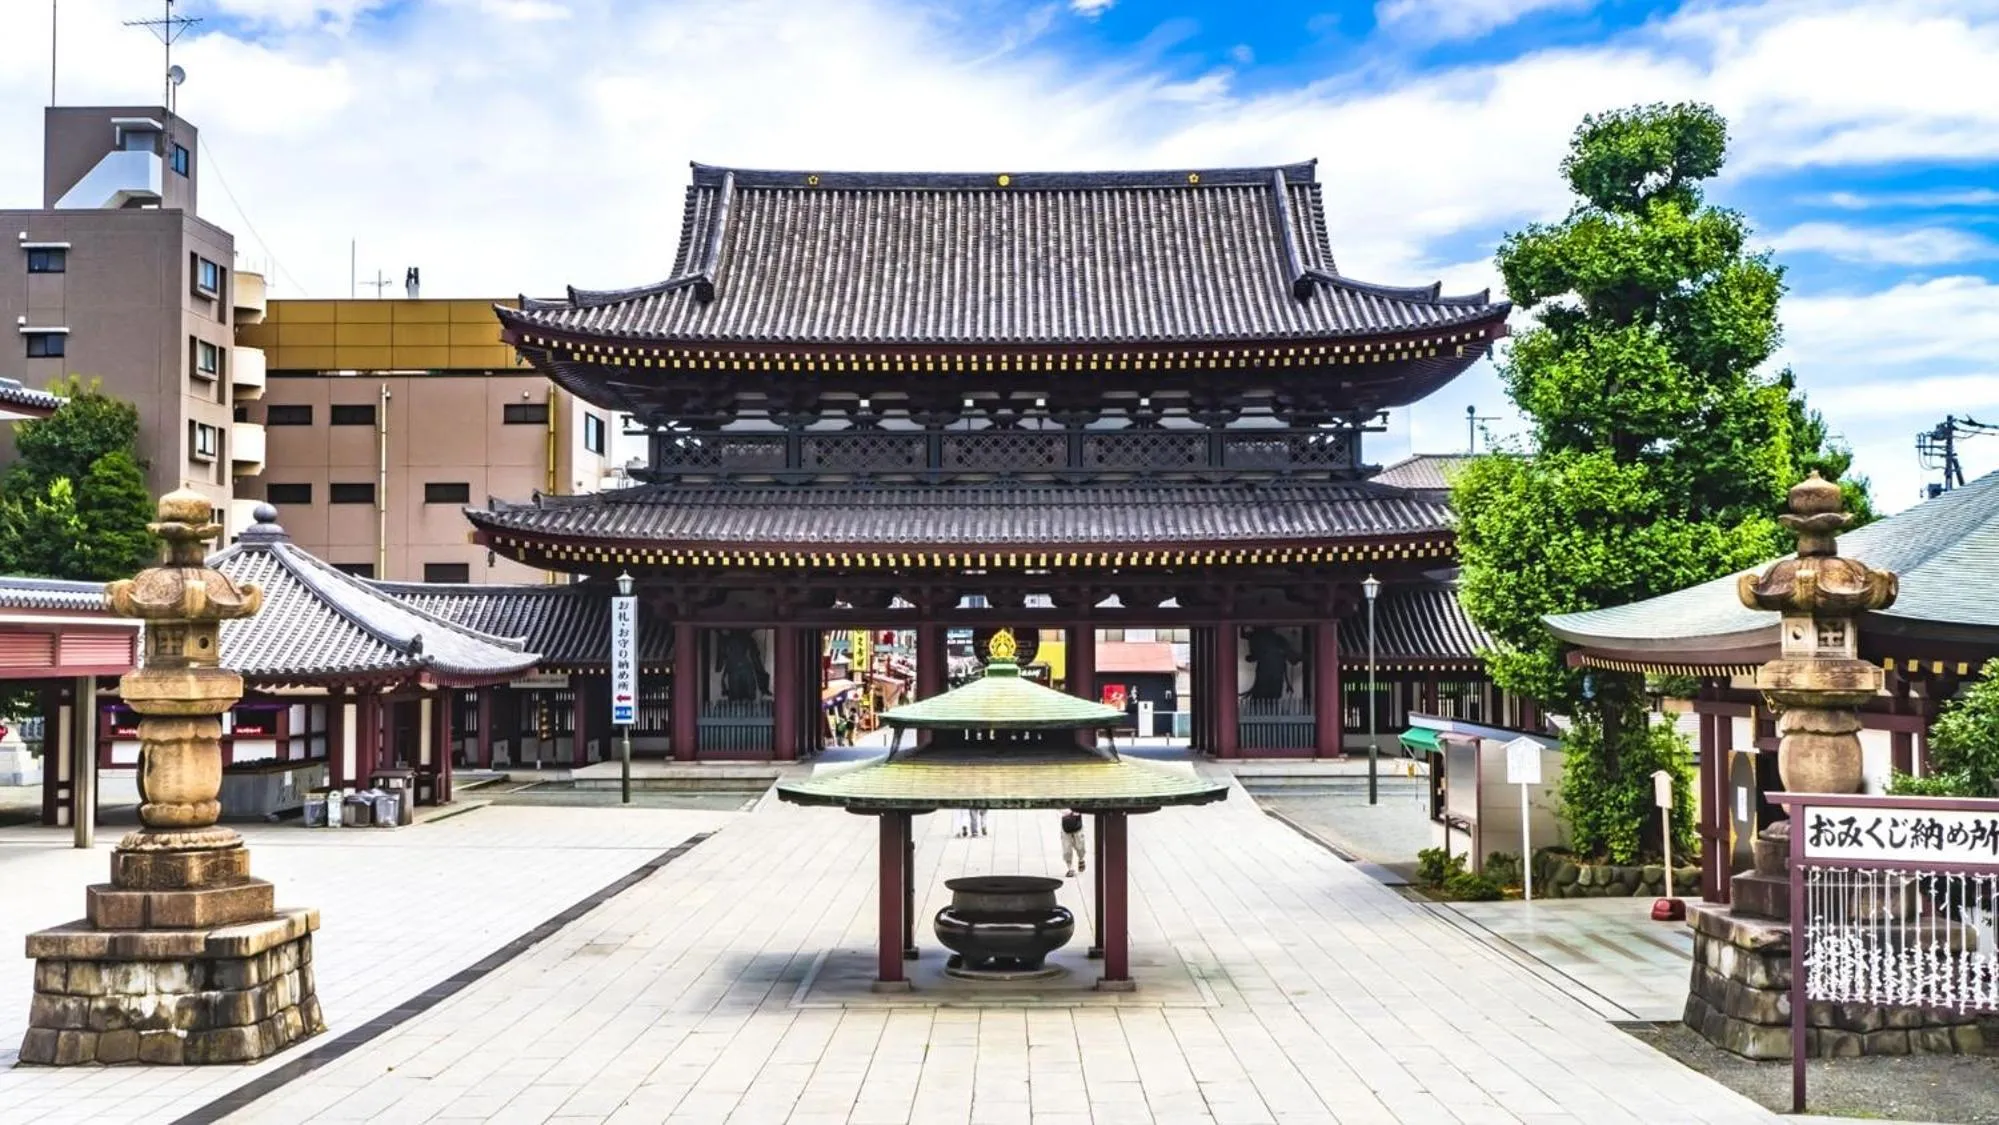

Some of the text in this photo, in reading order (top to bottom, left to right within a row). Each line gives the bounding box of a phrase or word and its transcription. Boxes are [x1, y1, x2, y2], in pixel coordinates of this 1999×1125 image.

[618, 600, 630, 691] お札・お守り納め所
[1809, 814, 1999, 856] おみくじ納め所
